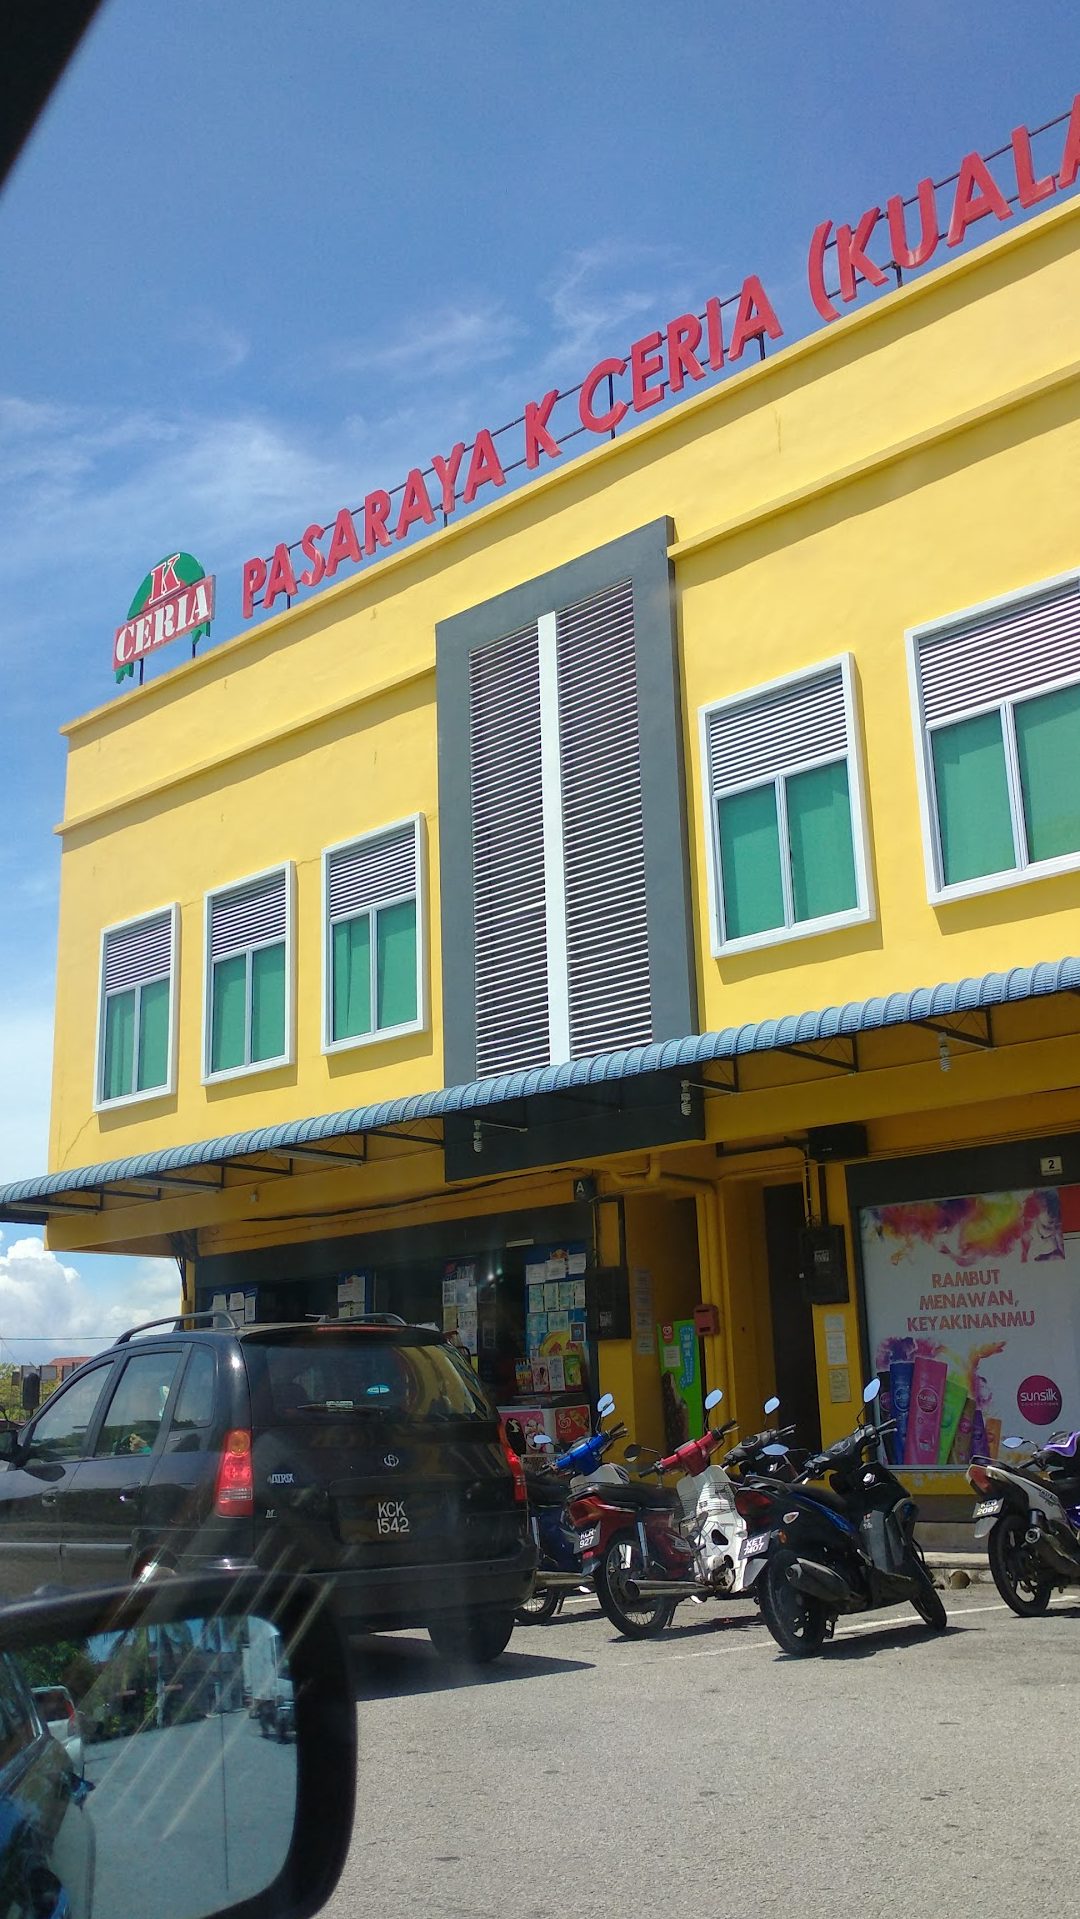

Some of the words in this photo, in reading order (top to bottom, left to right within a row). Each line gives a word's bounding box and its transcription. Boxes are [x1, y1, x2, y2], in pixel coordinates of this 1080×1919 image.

[243, 428, 507, 619] PASARAYA
[525, 389, 562, 469] K
[578, 274, 784, 433] CERIA
[148, 553, 181, 604] K
[114, 584, 210, 663] CERIA
[1048, 1159, 1055, 1169] 2
[931, 1269, 1000, 1288] RAMBUT
[919, 1290, 1020, 1310] MENAWAN,
[907, 1310, 1036, 1331] KEYAKINANMU
[1020, 1388, 1058, 1402] sunsilk
[377, 1501, 406, 1518] KCK
[976, 1505, 999, 1516] 2087
[377, 1517, 410, 1535] 1542
[580, 1536, 594, 1548] 927
[746, 1535, 765, 1548] KET
